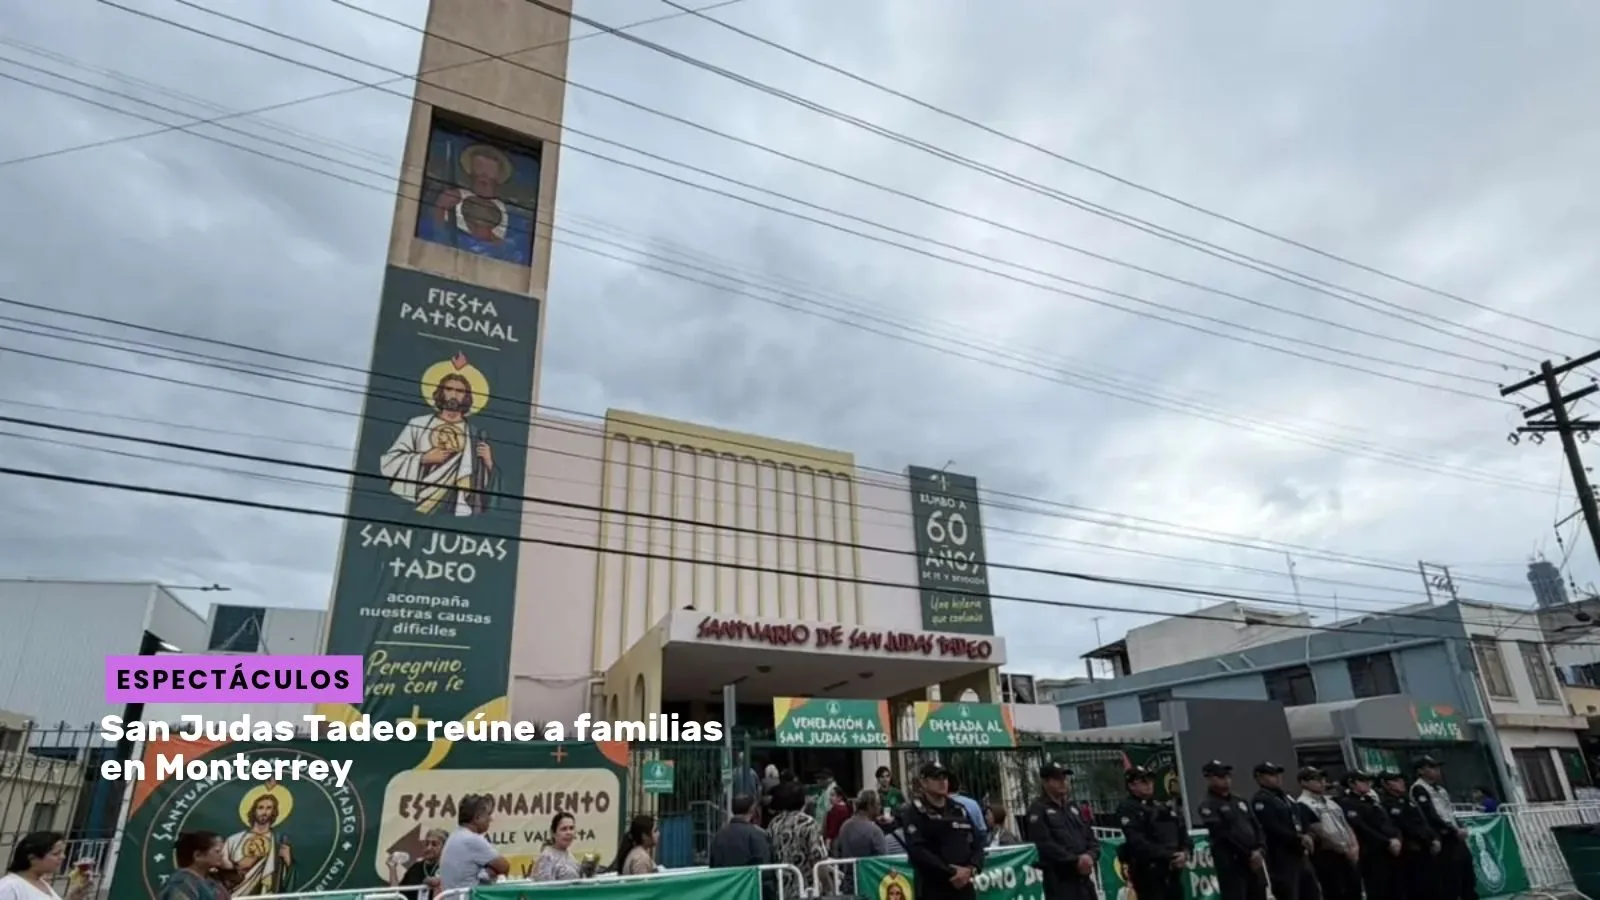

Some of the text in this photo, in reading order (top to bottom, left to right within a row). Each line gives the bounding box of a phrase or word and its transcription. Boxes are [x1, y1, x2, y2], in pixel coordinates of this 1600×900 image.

[428, 288, 497, 317] FIESTA
[400, 302, 519, 342] PATRONAL
[959, 501, 967, 510] A
[926, 510, 967, 545] 60
[360, 524, 508, 560] SAN JUDAS
[389, 557, 476, 583] TADEO
[925, 544, 979, 574] AÑOS
[387, 592, 470, 608] acompaña
[360, 607, 492, 625] nuestras causas
[696, 616, 992, 660] SANTUARIO DE SAN JUDAS TADEO
[404, 680, 438, 694] con
[445, 675, 464, 692] fe
[792, 716, 876, 730] VENERACIÓN A
[929, 718, 1004, 733] ENTRADA AL
[780, 731, 889, 745] SAN JUDAS TADEO
[947, 732, 990, 745] TEMPLO
[400, 790, 610, 820] ESTAONAMIENTO
